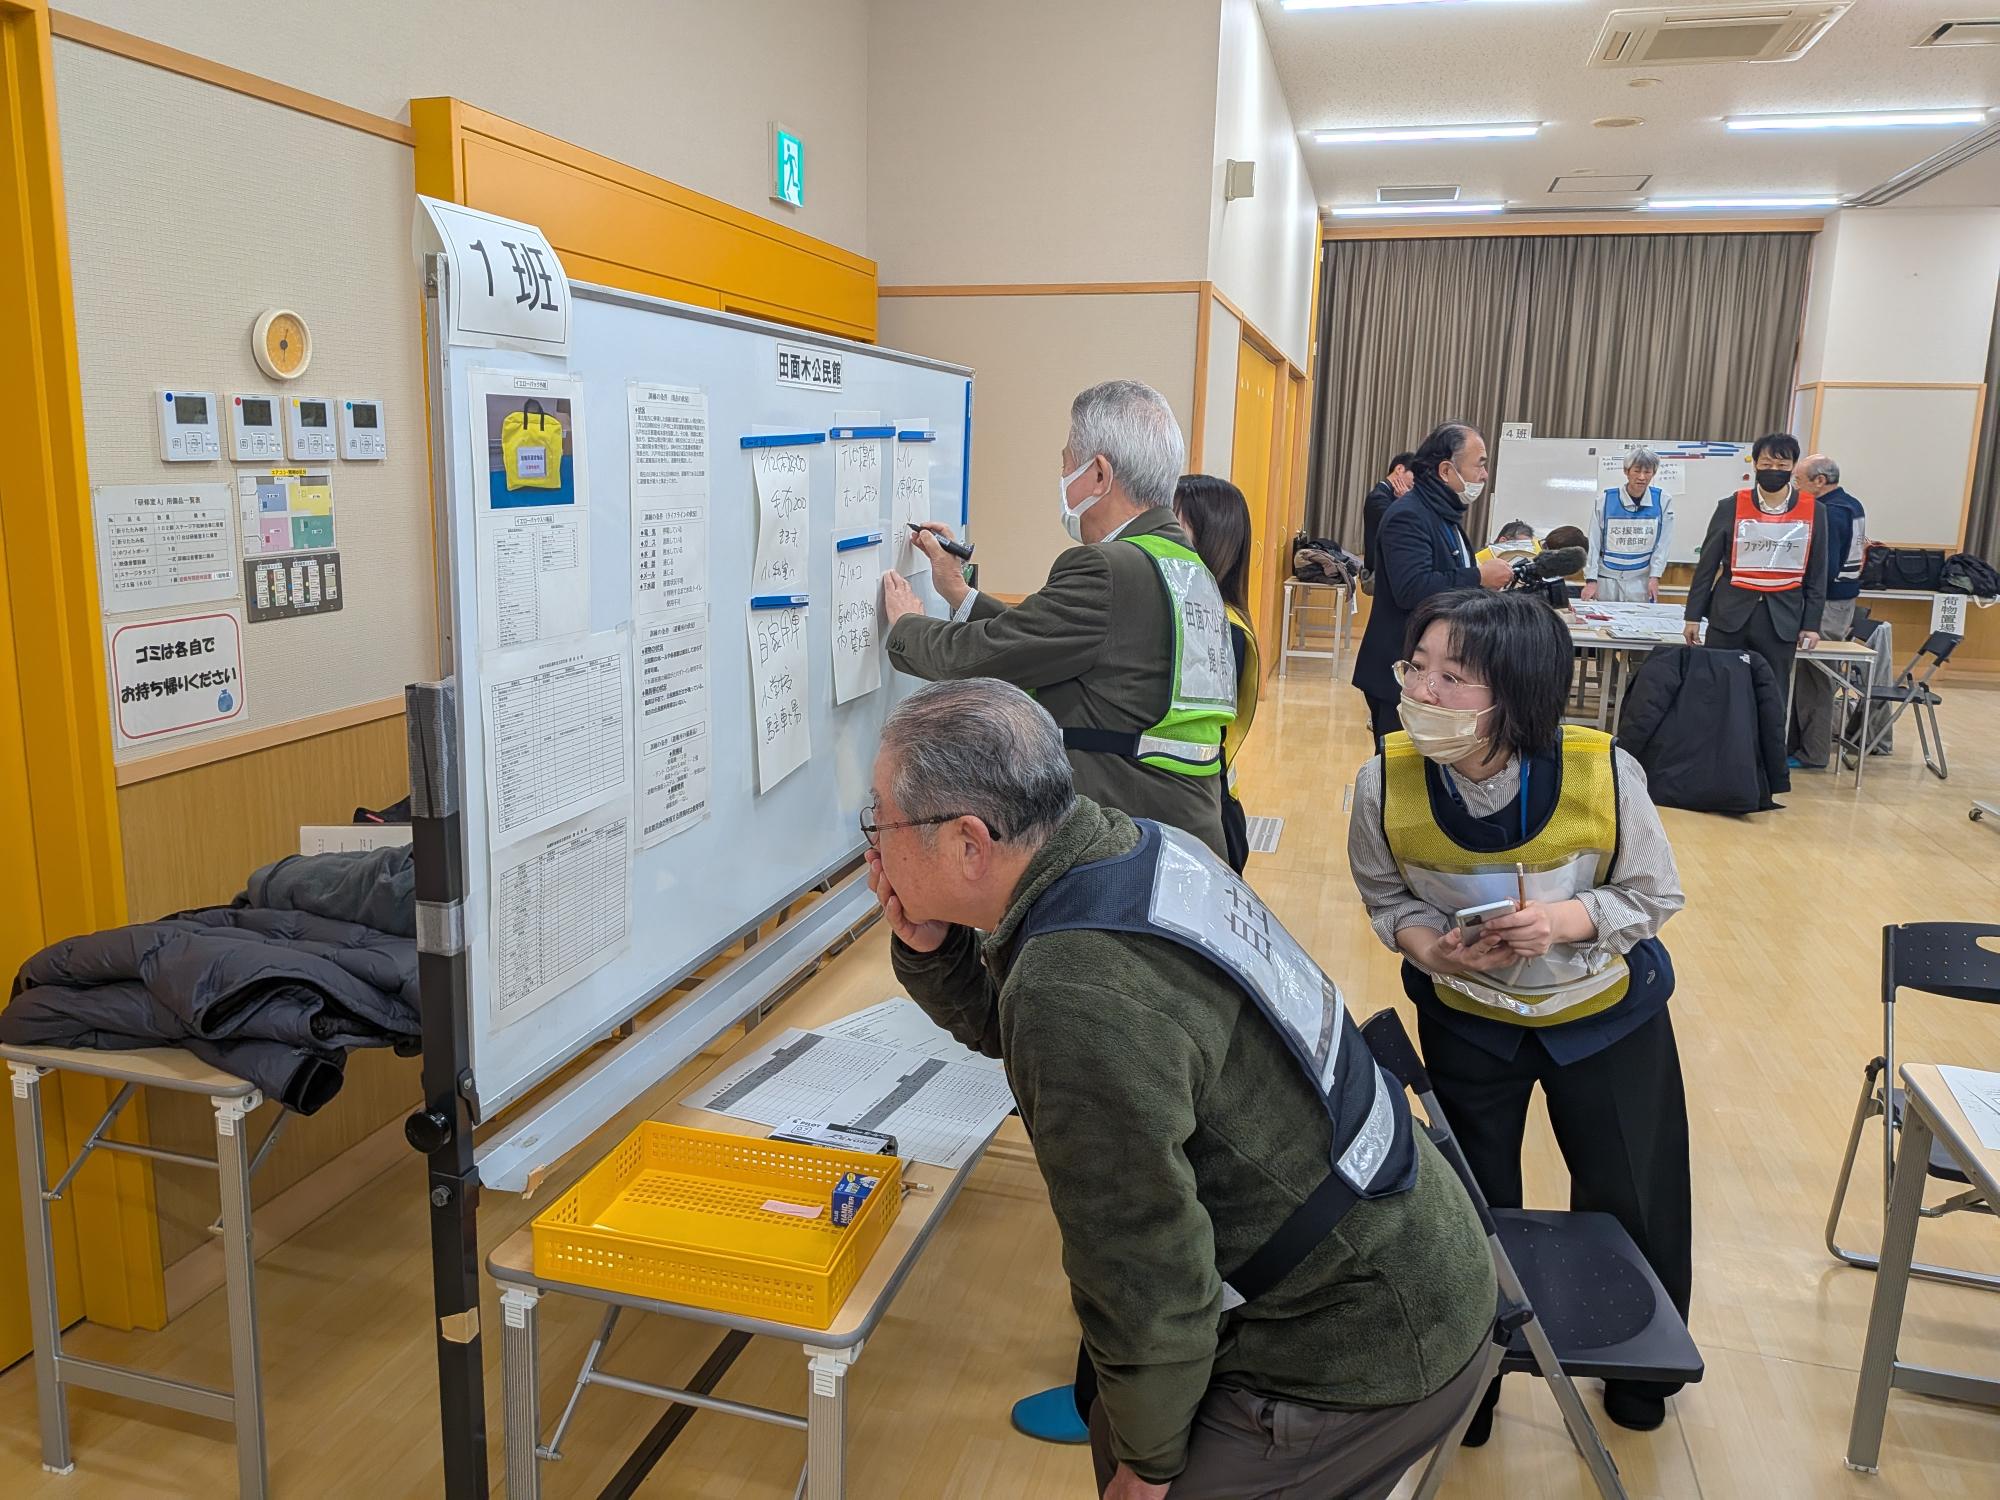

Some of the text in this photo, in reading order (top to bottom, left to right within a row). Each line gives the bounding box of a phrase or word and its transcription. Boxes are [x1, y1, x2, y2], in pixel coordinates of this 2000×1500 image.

[469, 240, 558, 312] 1班
[779, 352, 841, 385] 田面木公民館
[1506, 428, 1527, 439] 4班
[1610, 526, 1654, 535] 応援職員
[1615, 537, 1648, 546] 南部町
[1744, 540, 1800, 552] ファシリテーター
[1939, 596, 1959, 633] 荷物置場
[135, 636, 215, 664] ゴミは各自で
[121, 667, 237, 703] お持ち帰りください
[840, 1203, 848, 1224] HAND
